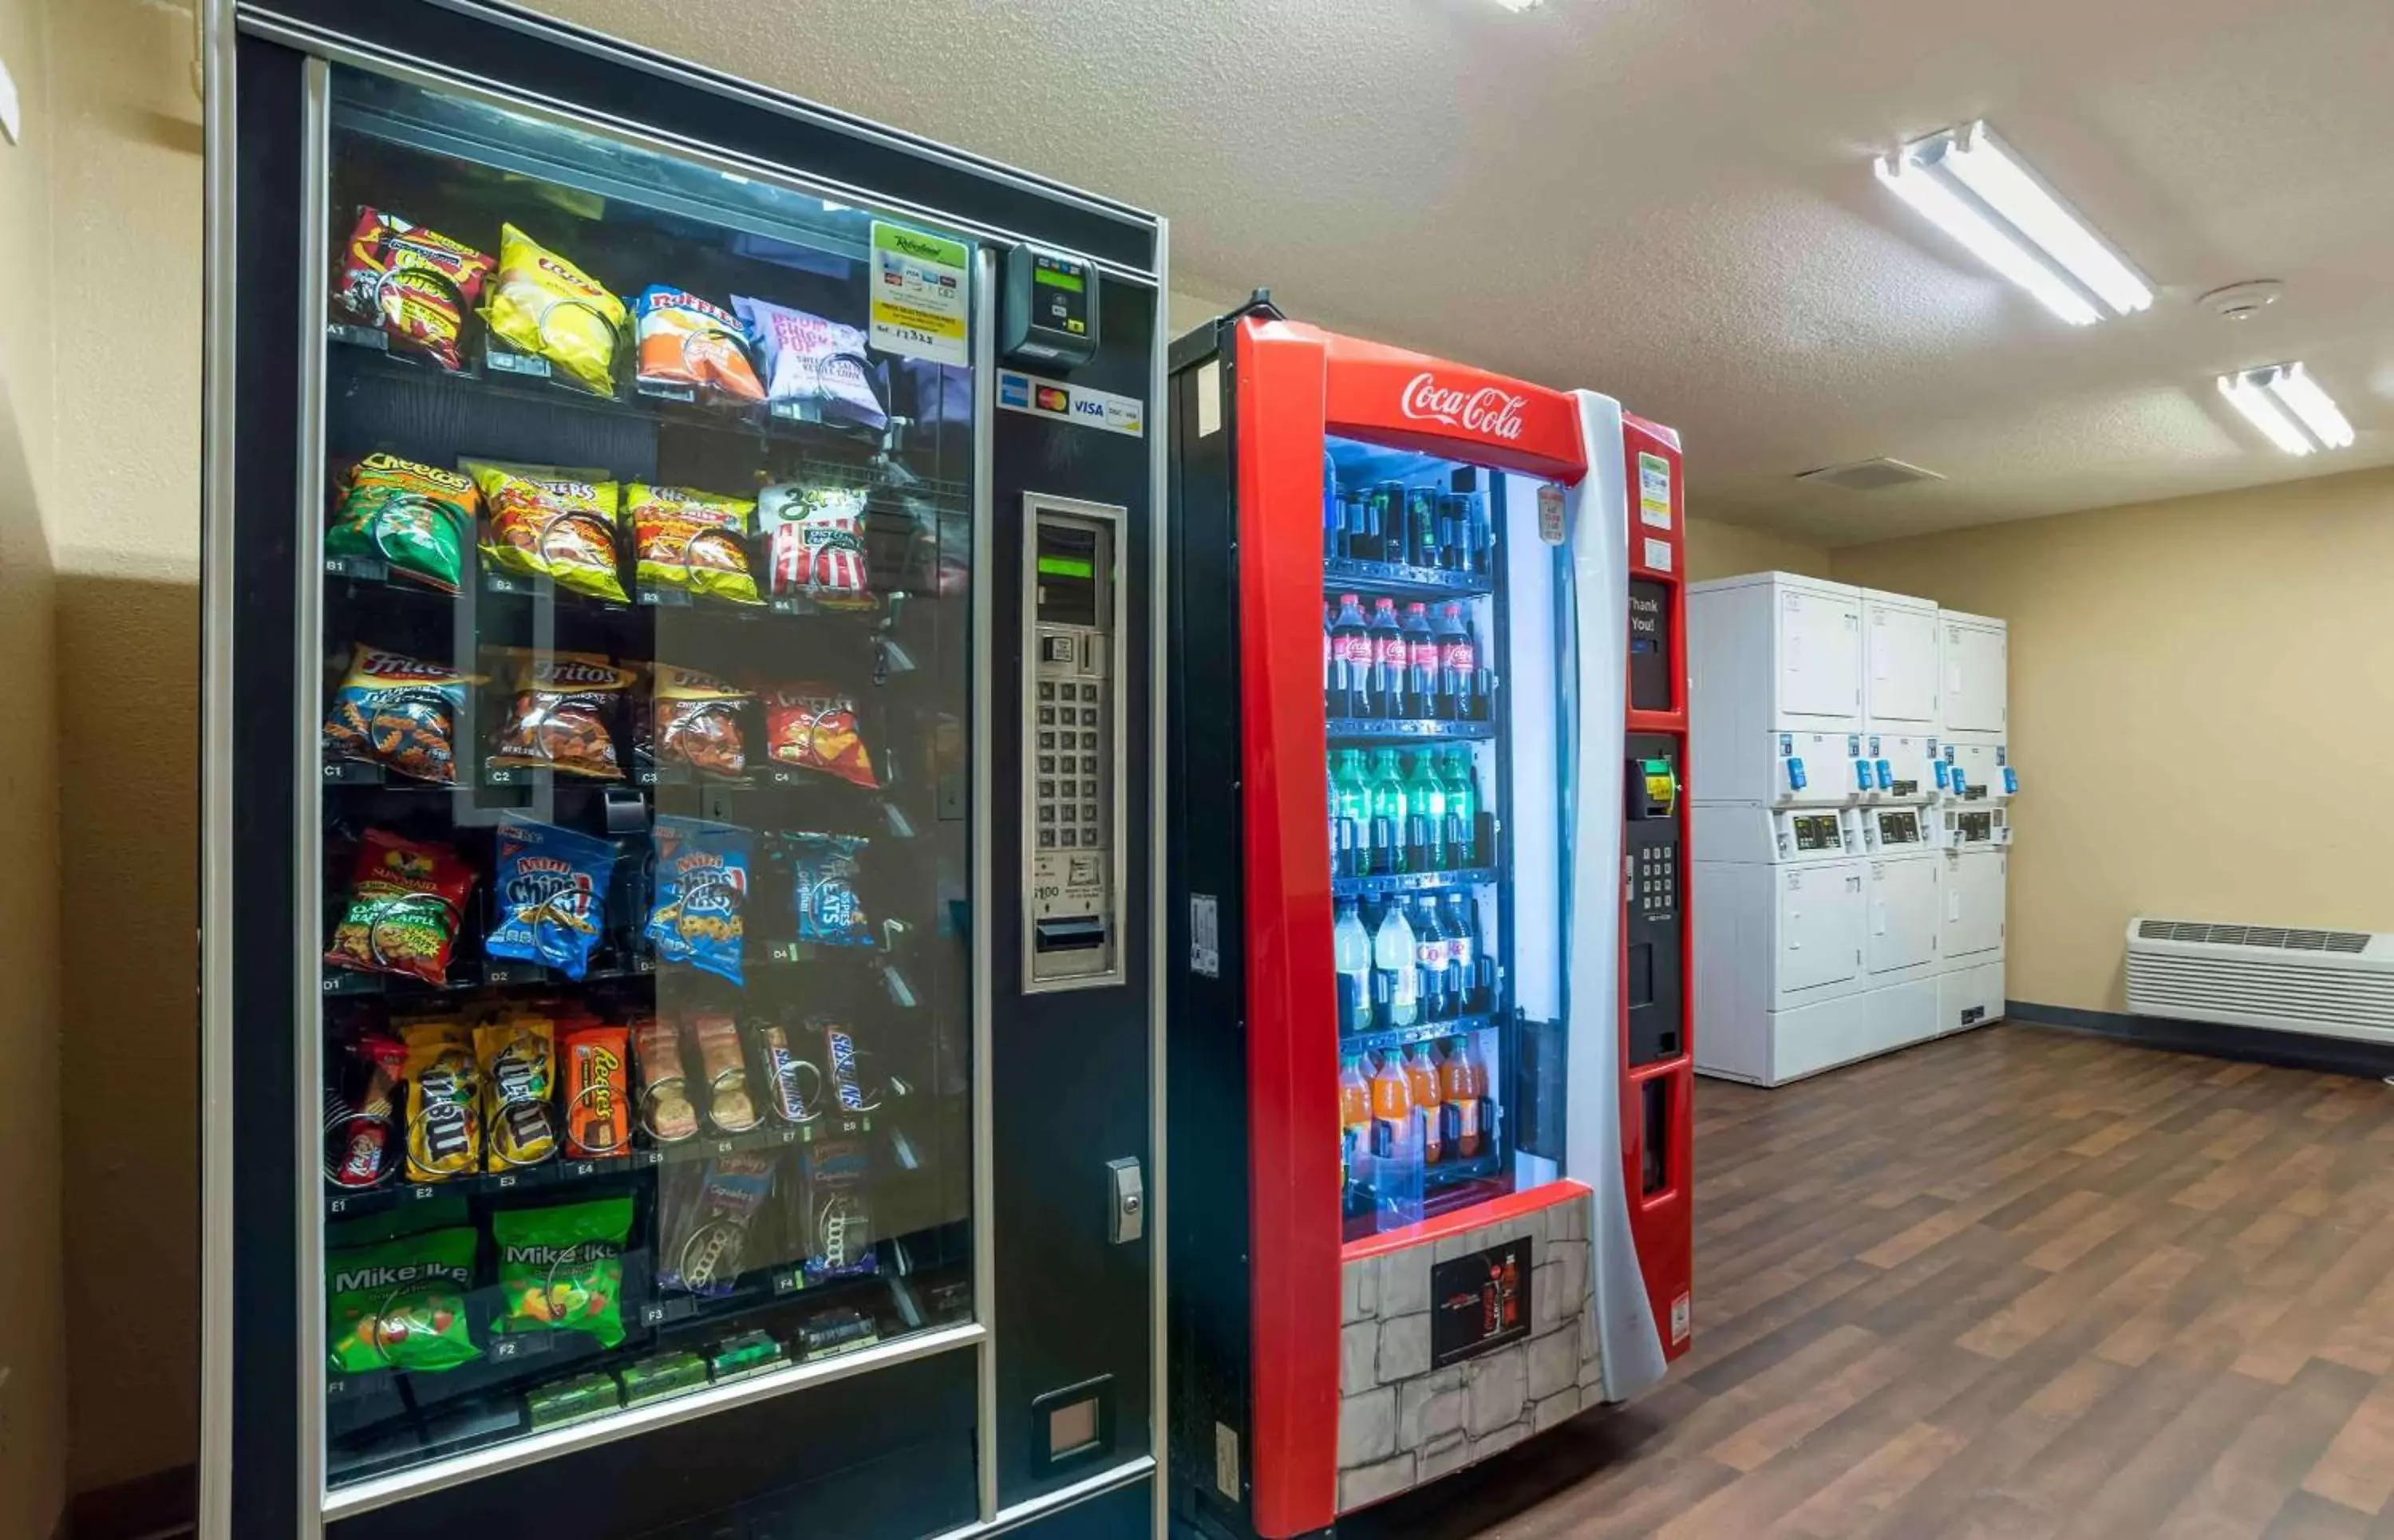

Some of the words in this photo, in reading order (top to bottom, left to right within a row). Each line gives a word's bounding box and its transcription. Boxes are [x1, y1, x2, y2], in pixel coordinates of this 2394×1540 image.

[1075, 401, 1103, 417] VISA
[326, 561, 344, 572] B1
[496, 579, 512, 590] B2
[324, 763, 342, 776] C1
[492, 770, 510, 782] C2
[775, 772, 788, 782] C4
[773, 950, 788, 959] D4
[491, 971, 508, 982] D2
[323, 980, 339, 991] D1
[783, 1132, 795, 1143] E7
[650, 1154, 664, 1163] E5
[578, 1164, 594, 1175] E4
[500, 1176, 516, 1187] E3
[416, 1187, 433, 1198] E2
[331, 1201, 346, 1212] E1
[507, 1245, 576, 1264] Mike
[336, 1266, 417, 1293] Mike
[427, 1263, 468, 1283] Ike
[780, 1278, 793, 1289] F4
[648, 1309, 663, 1321] F3
[499, 1343, 516, 1356] F2
[329, 1381, 344, 1393] F1
